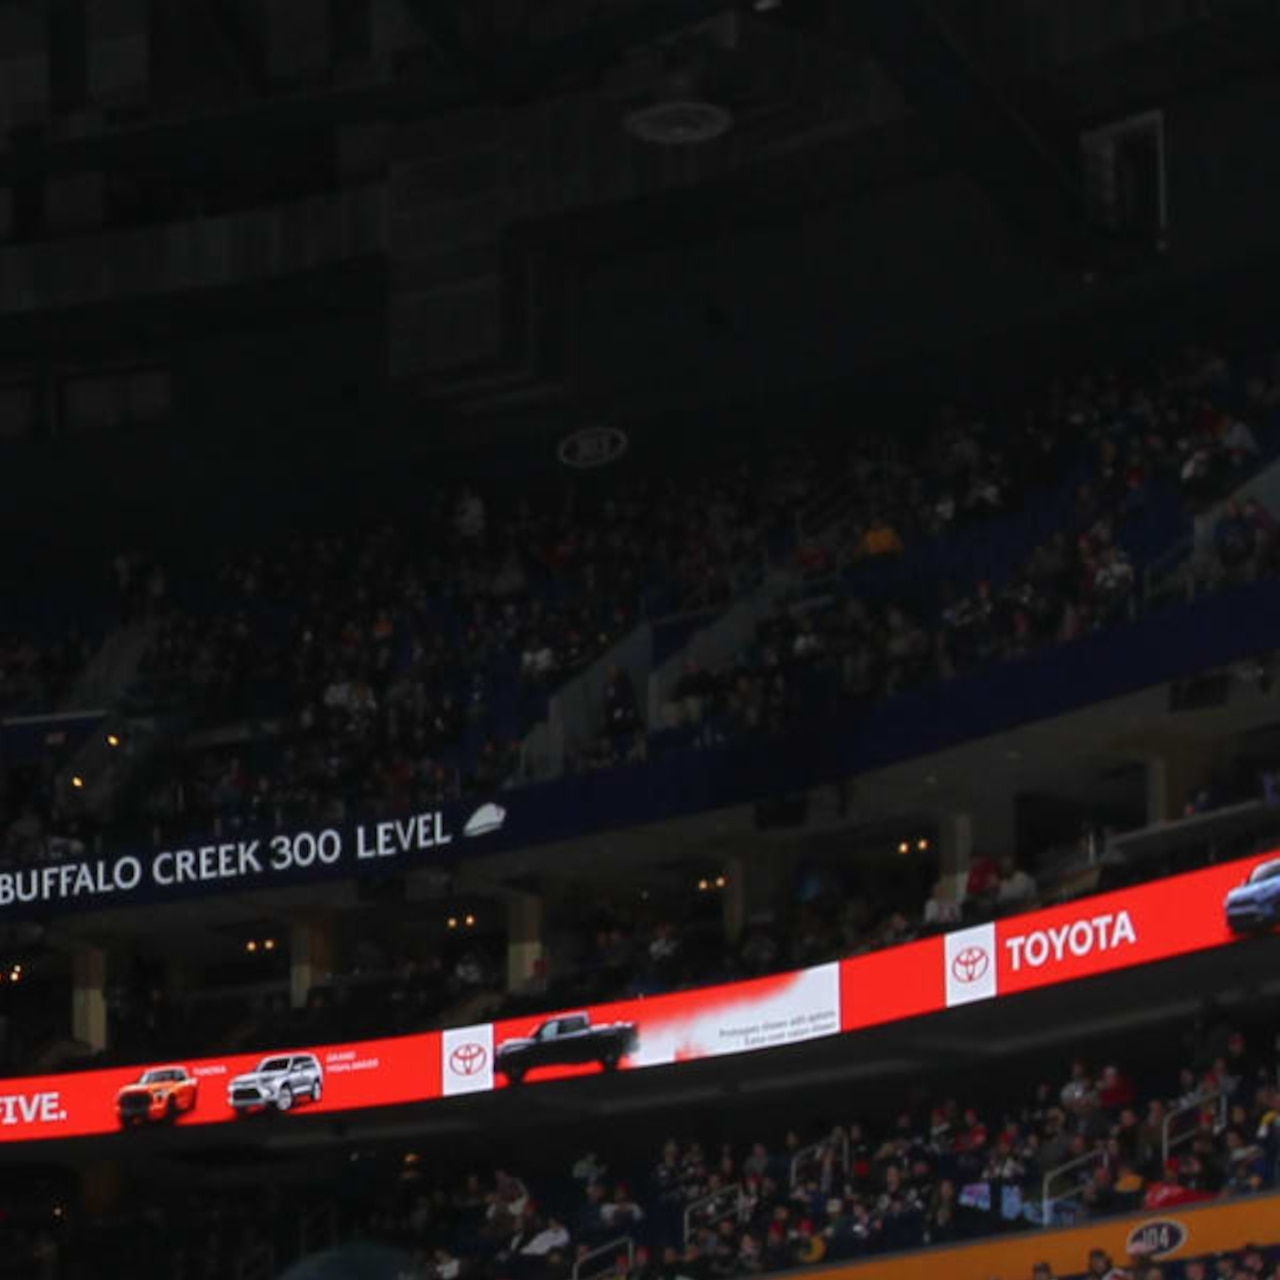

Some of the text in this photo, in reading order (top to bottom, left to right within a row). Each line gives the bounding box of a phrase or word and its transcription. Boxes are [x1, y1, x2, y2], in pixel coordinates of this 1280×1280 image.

[151, 839, 263, 887] CREEK
[268, 827, 341, 873] 300
[356, 811, 452, 861] LEVEL
[1006, 909, 1137, 972] TOYOTA
